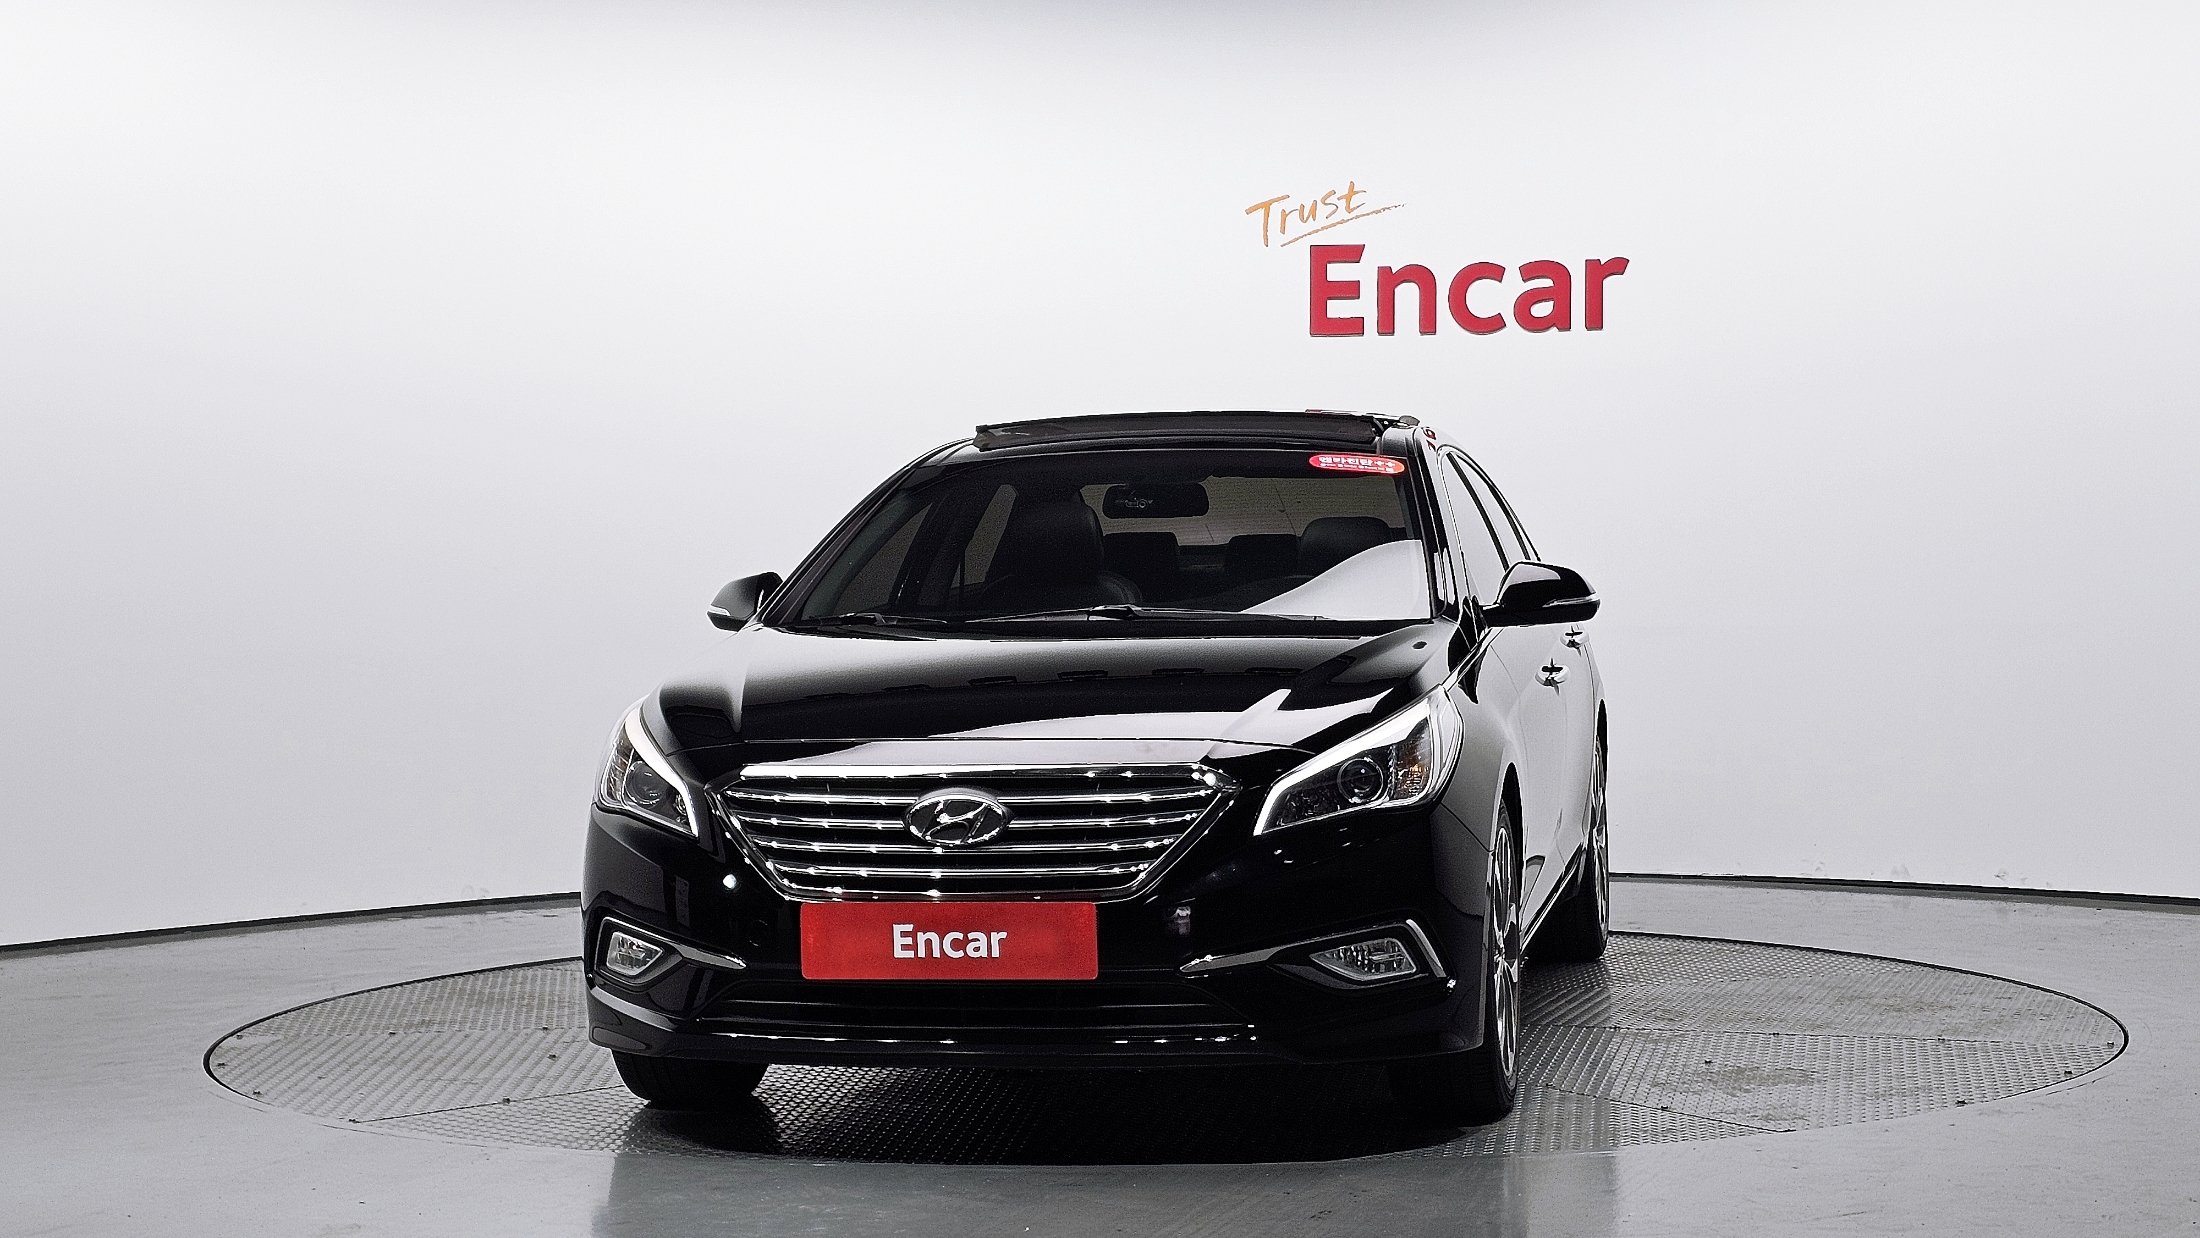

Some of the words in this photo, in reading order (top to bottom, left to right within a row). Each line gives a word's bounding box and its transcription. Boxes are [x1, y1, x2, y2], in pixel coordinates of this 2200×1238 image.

[1246, 181, 1368, 247] Trust
[1309, 244, 1630, 337] Encar
[892, 923, 1007, 958] Encar
